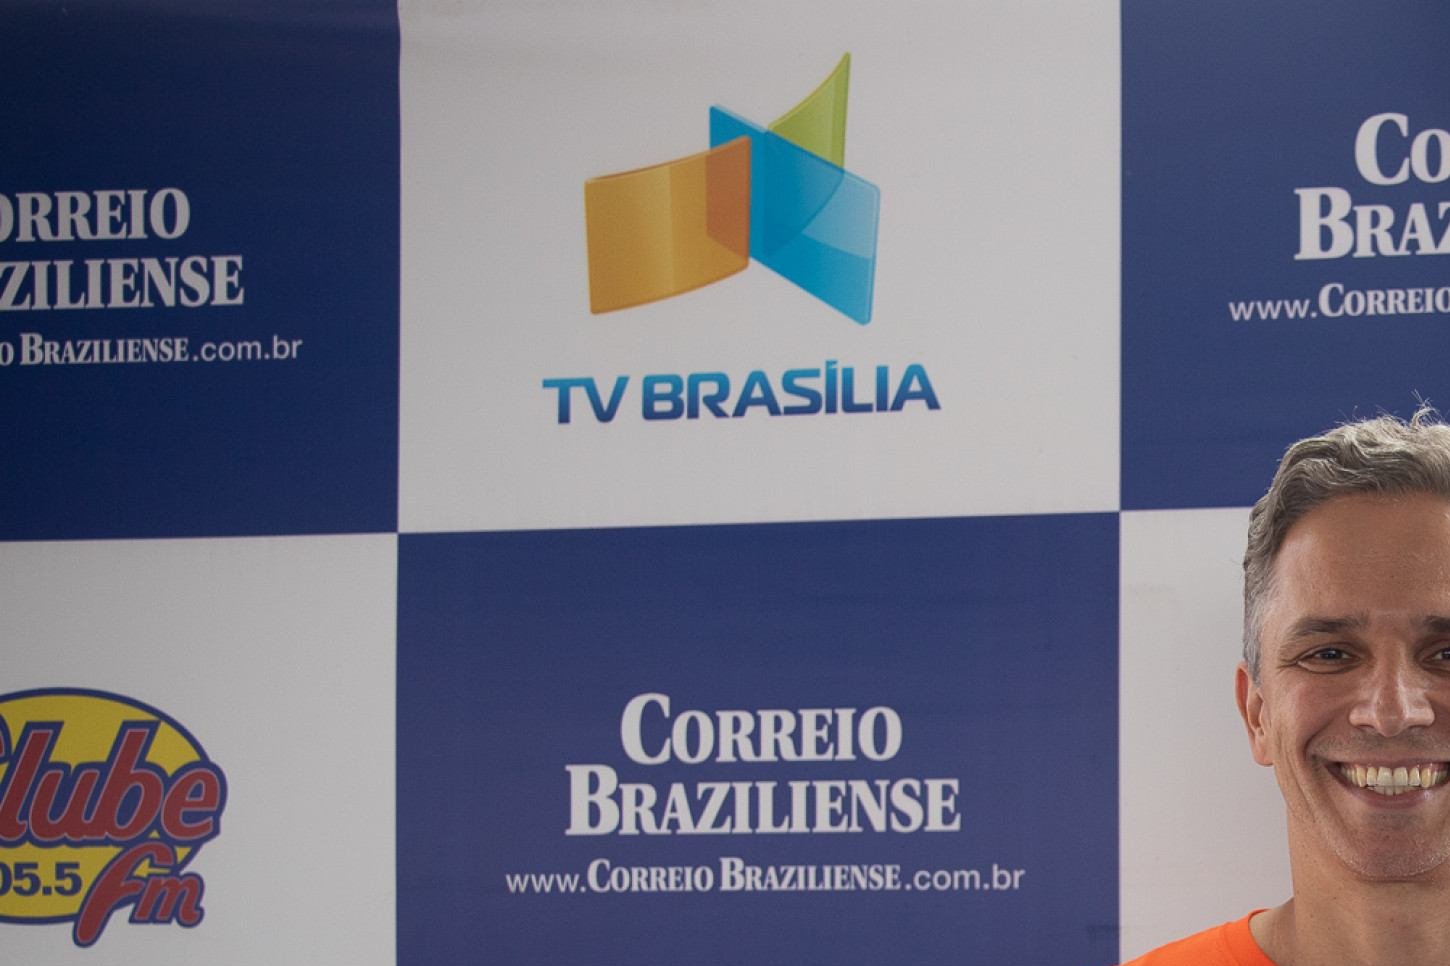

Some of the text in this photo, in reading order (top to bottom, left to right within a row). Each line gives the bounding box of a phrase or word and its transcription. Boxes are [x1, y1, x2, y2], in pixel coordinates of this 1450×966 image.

[542, 359, 942, 424] TV BRASÍLIA
[620, 693, 902, 765] CORREIO
[565, 764, 961, 836] BRAZILIENSE
[73, 840, 204, 948] fm
